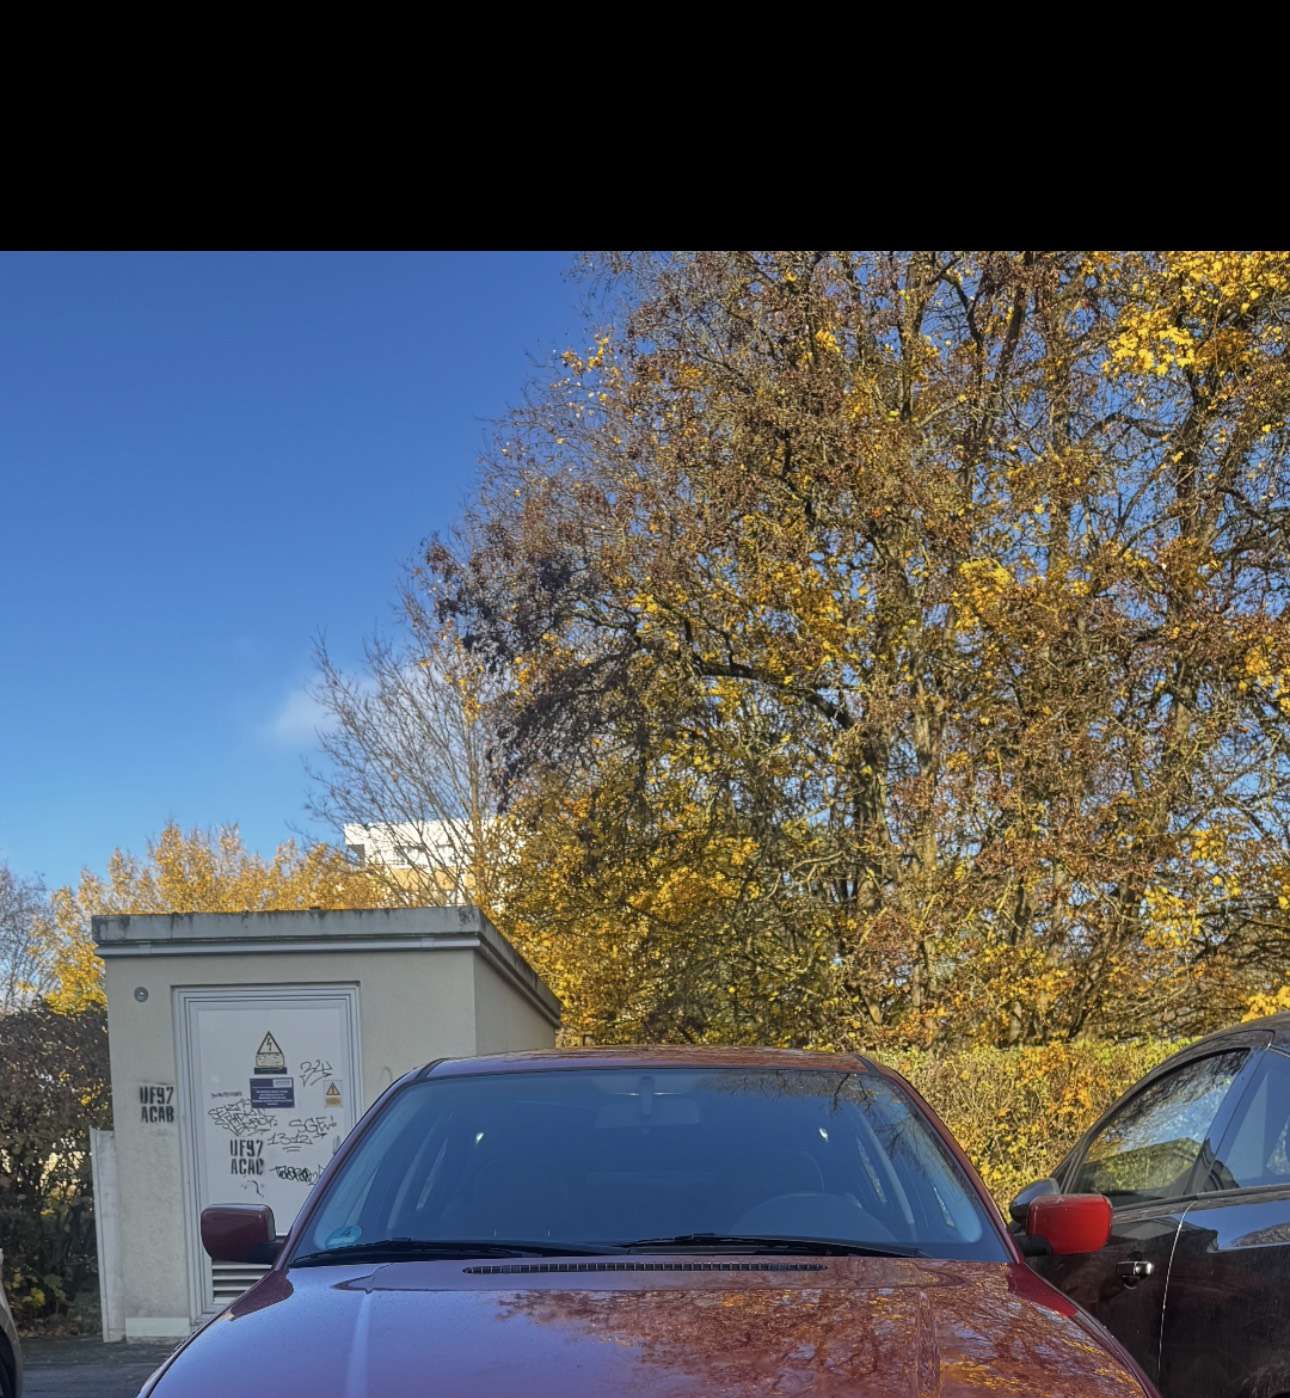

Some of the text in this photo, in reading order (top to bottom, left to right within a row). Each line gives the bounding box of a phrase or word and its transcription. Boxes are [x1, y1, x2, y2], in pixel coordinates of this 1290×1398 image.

[139, 1086, 174, 1105] UF97
[140, 1106, 174, 1123] ACAB
[230, 1139, 263, 1157] UF97
